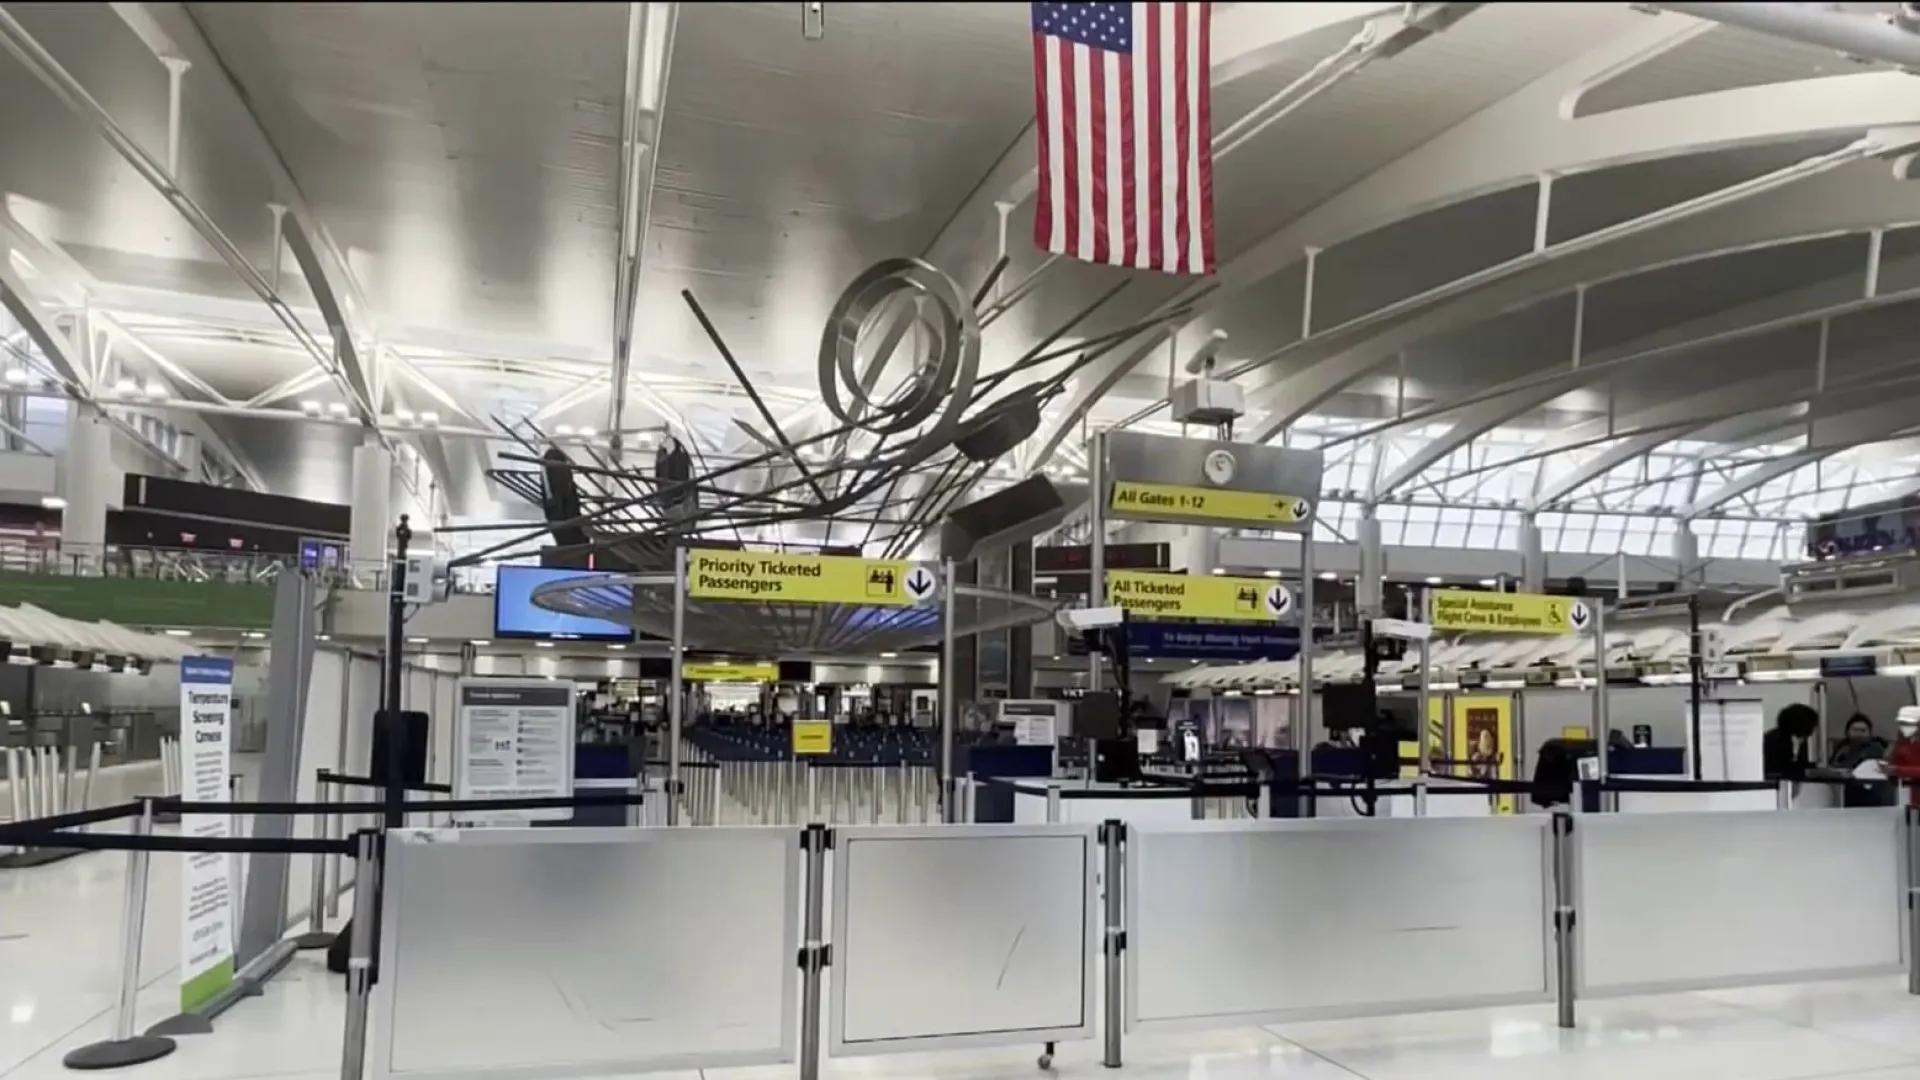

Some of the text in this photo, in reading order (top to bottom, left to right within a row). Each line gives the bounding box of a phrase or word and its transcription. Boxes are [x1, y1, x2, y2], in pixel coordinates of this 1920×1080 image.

[1117, 489, 1205, 508] All Gates 1-12
[699, 557, 821, 577] Priority Ticketed
[699, 574, 782, 593] Passengers
[1113, 580, 1185, 596] All Ticketed
[1113, 595, 1181, 612] Passengers
[1438, 596, 1514, 612] Special Assistance
